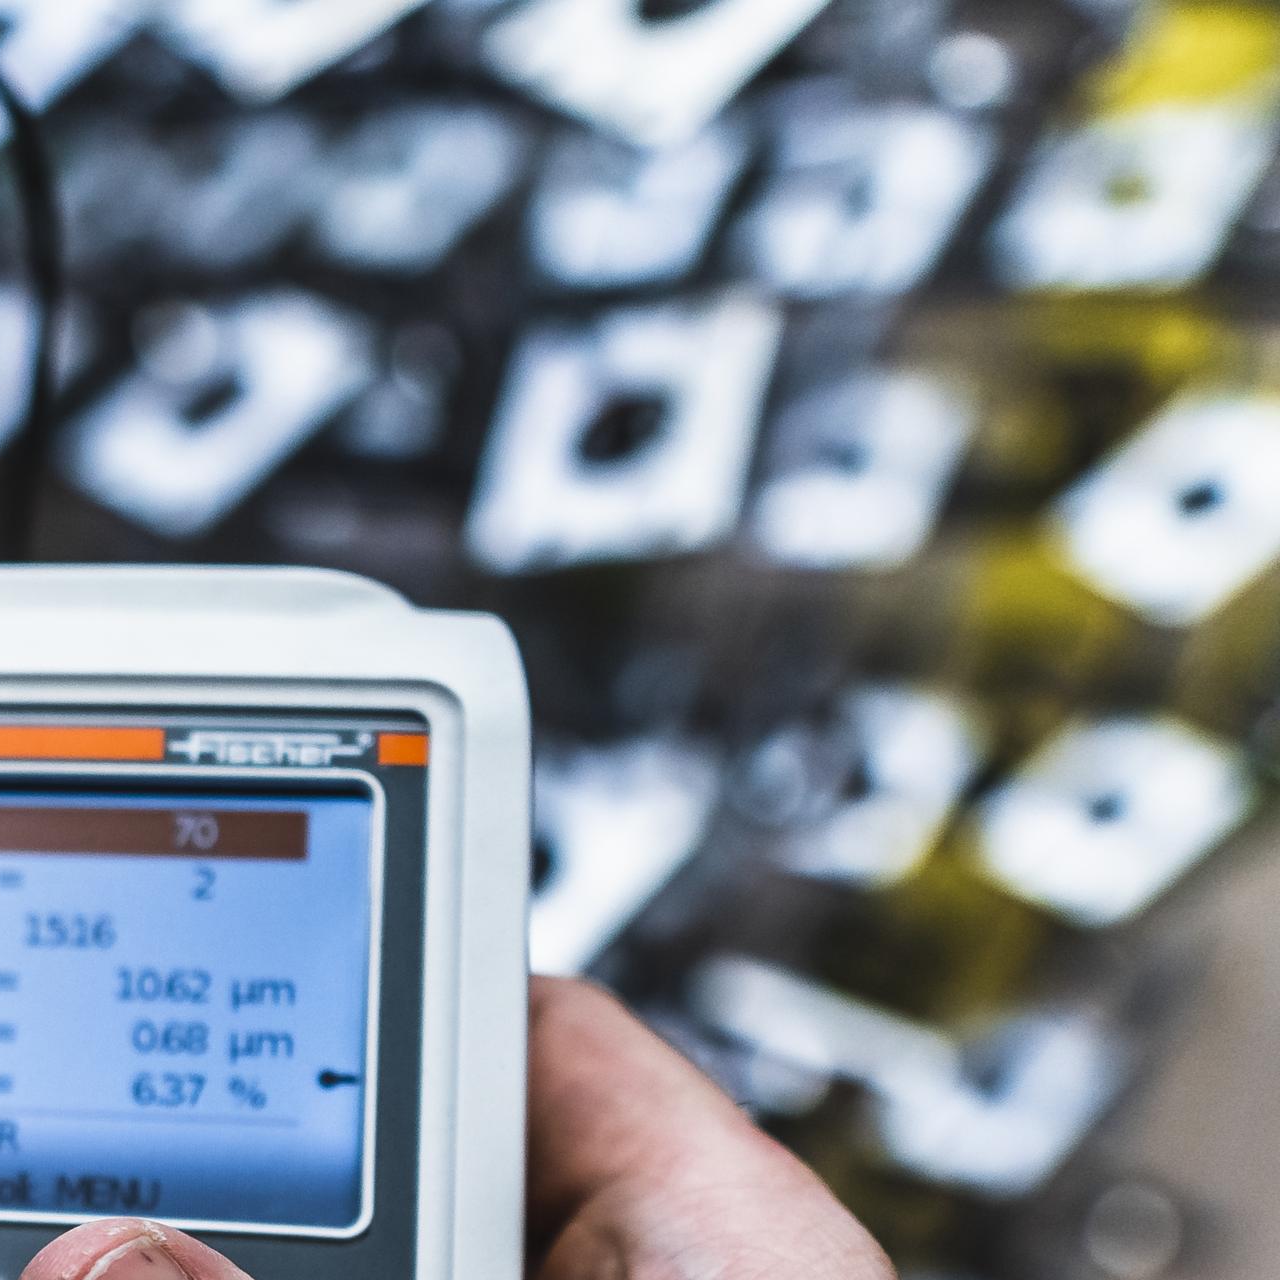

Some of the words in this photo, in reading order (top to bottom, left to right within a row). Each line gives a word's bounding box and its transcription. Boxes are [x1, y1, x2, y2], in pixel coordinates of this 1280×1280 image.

[174, 815, 219, 848] 70
[191, 869, 217, 901] 2
[227, 1074, 268, 1111] %
[56, 1173, 163, 1212] MENU
